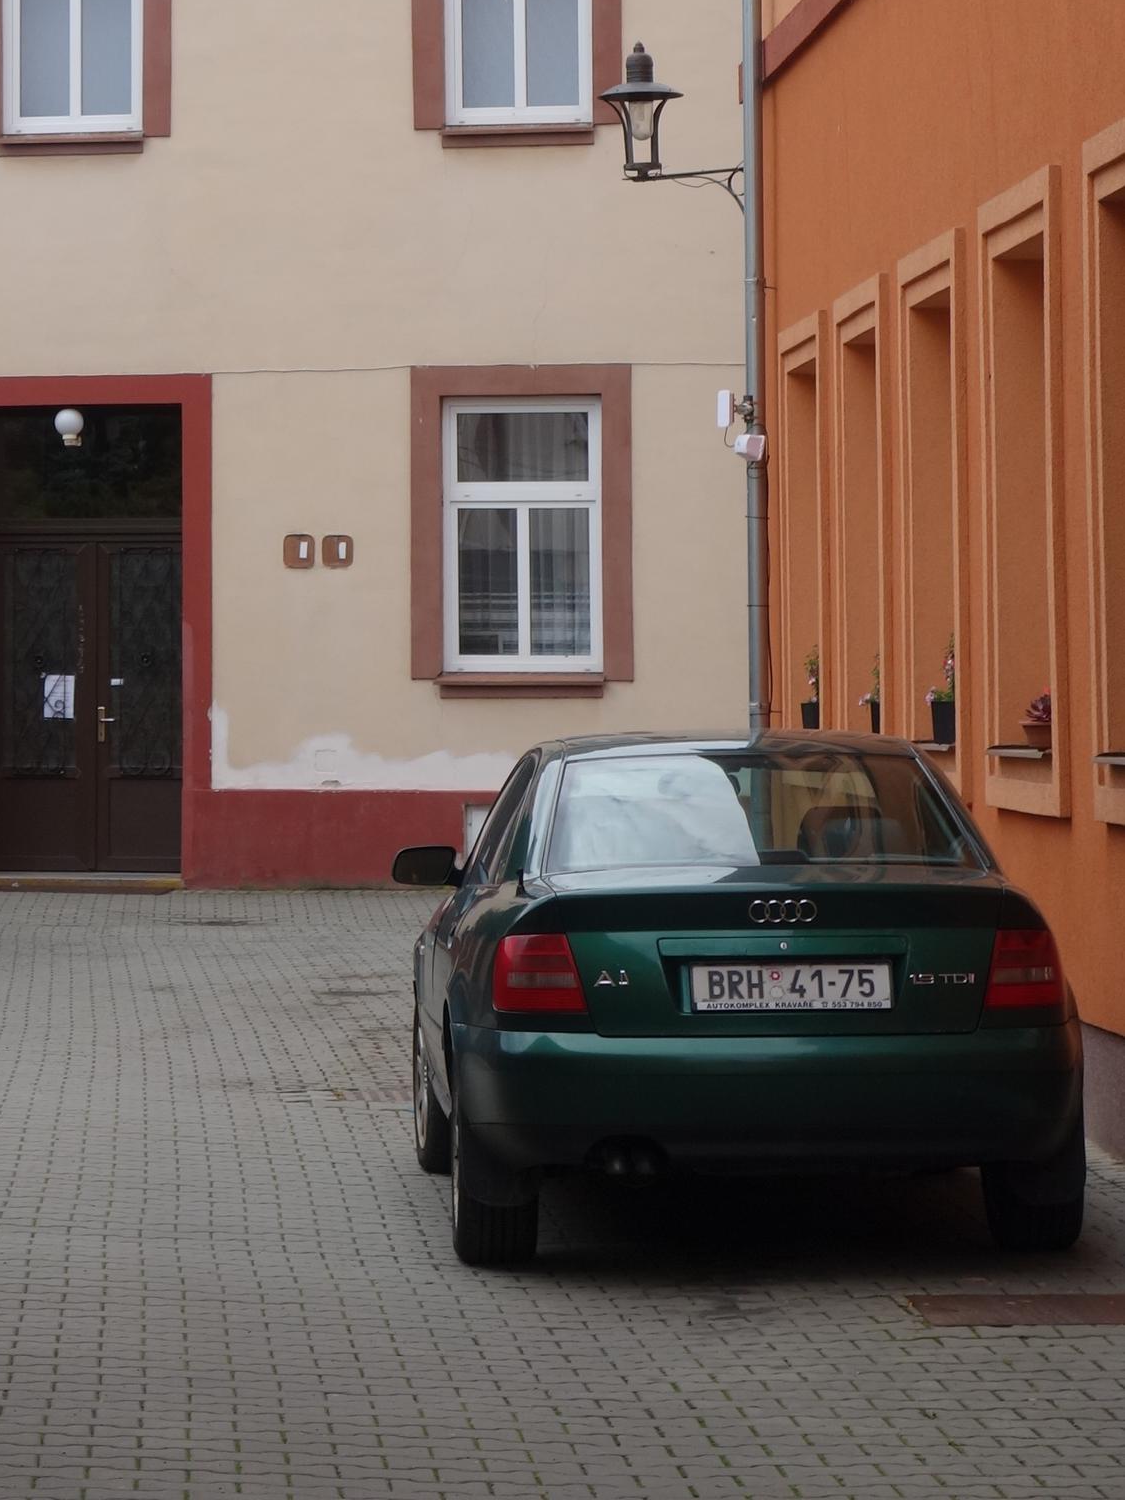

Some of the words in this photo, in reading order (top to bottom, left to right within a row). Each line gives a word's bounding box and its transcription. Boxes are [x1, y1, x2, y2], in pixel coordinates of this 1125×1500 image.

[707, 969, 765, 1000] BRH
[788, 968, 876, 999] 41-75
[938, 973, 975, 984] TDI
